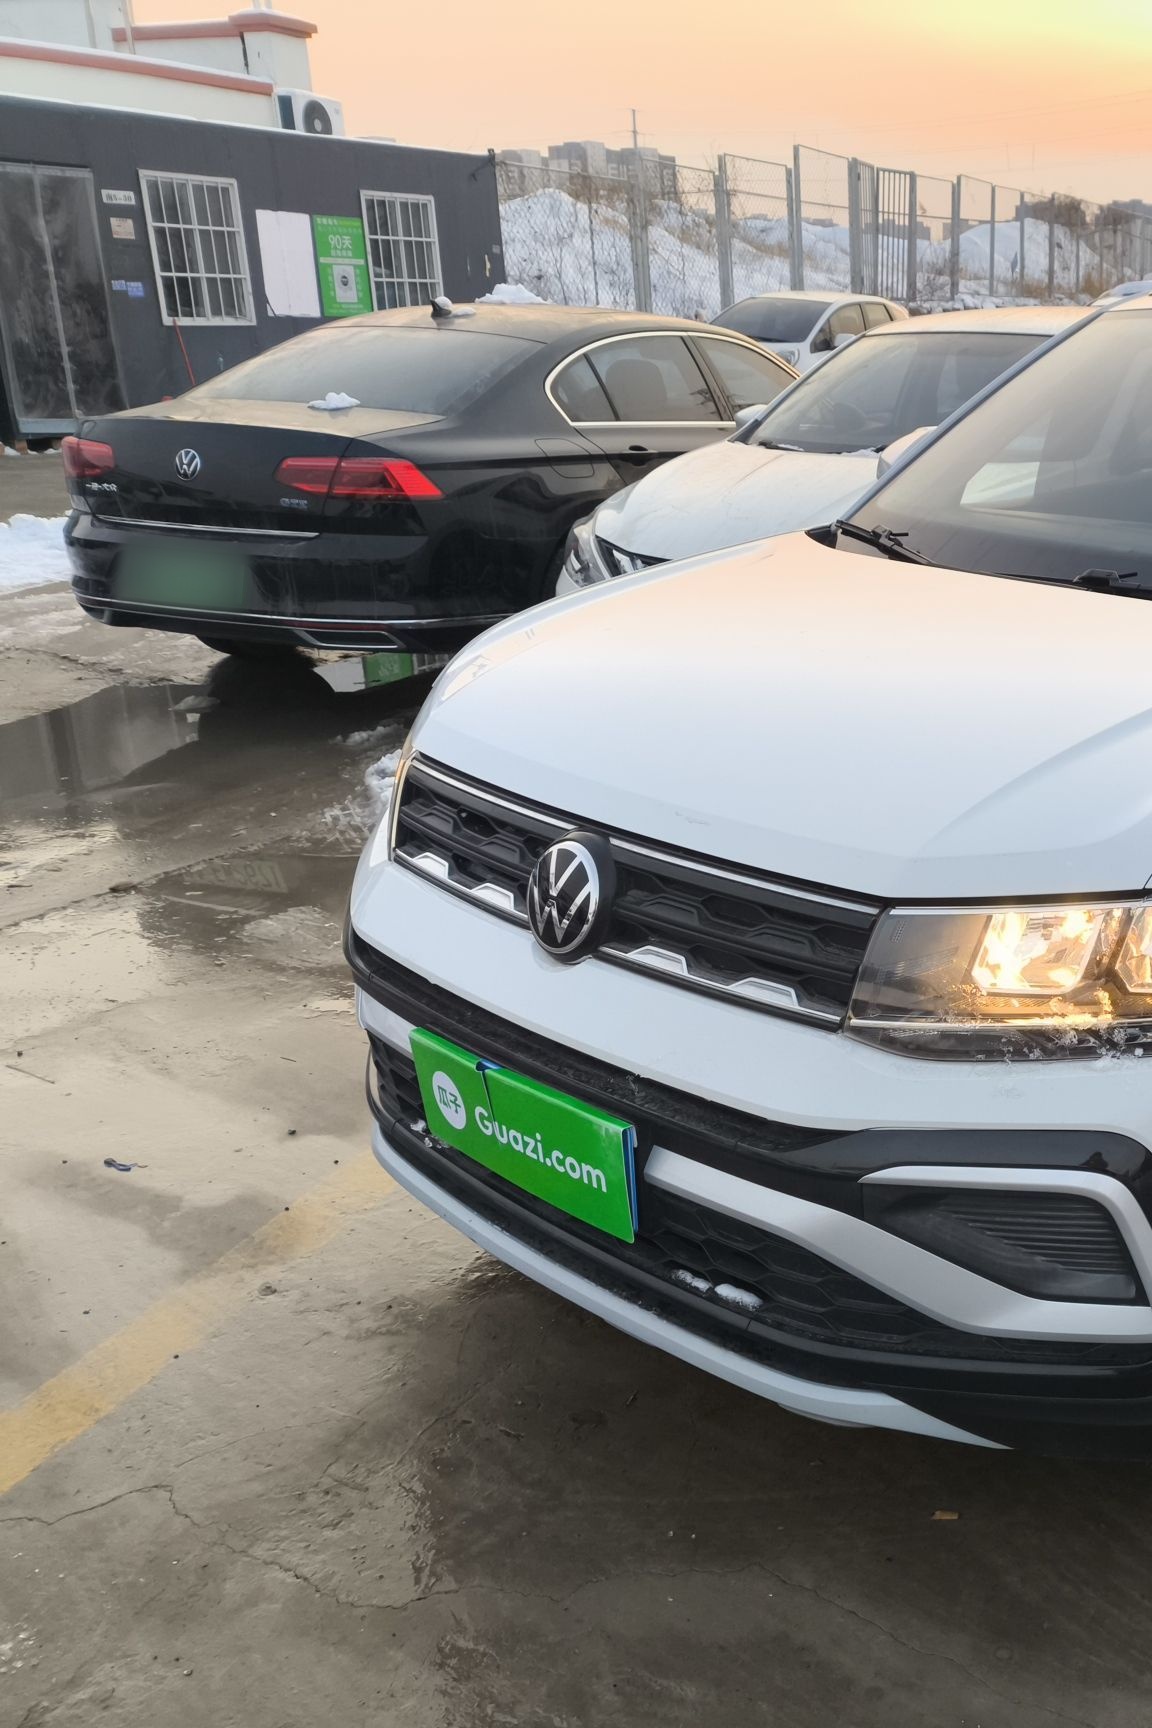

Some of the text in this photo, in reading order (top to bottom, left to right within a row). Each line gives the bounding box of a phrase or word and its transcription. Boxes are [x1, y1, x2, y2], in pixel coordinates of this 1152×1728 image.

[328, 234, 352, 249] 90天
[437, 1085, 462, 1115] 瓜子
[474, 1107, 608, 1193] Guazi.com
